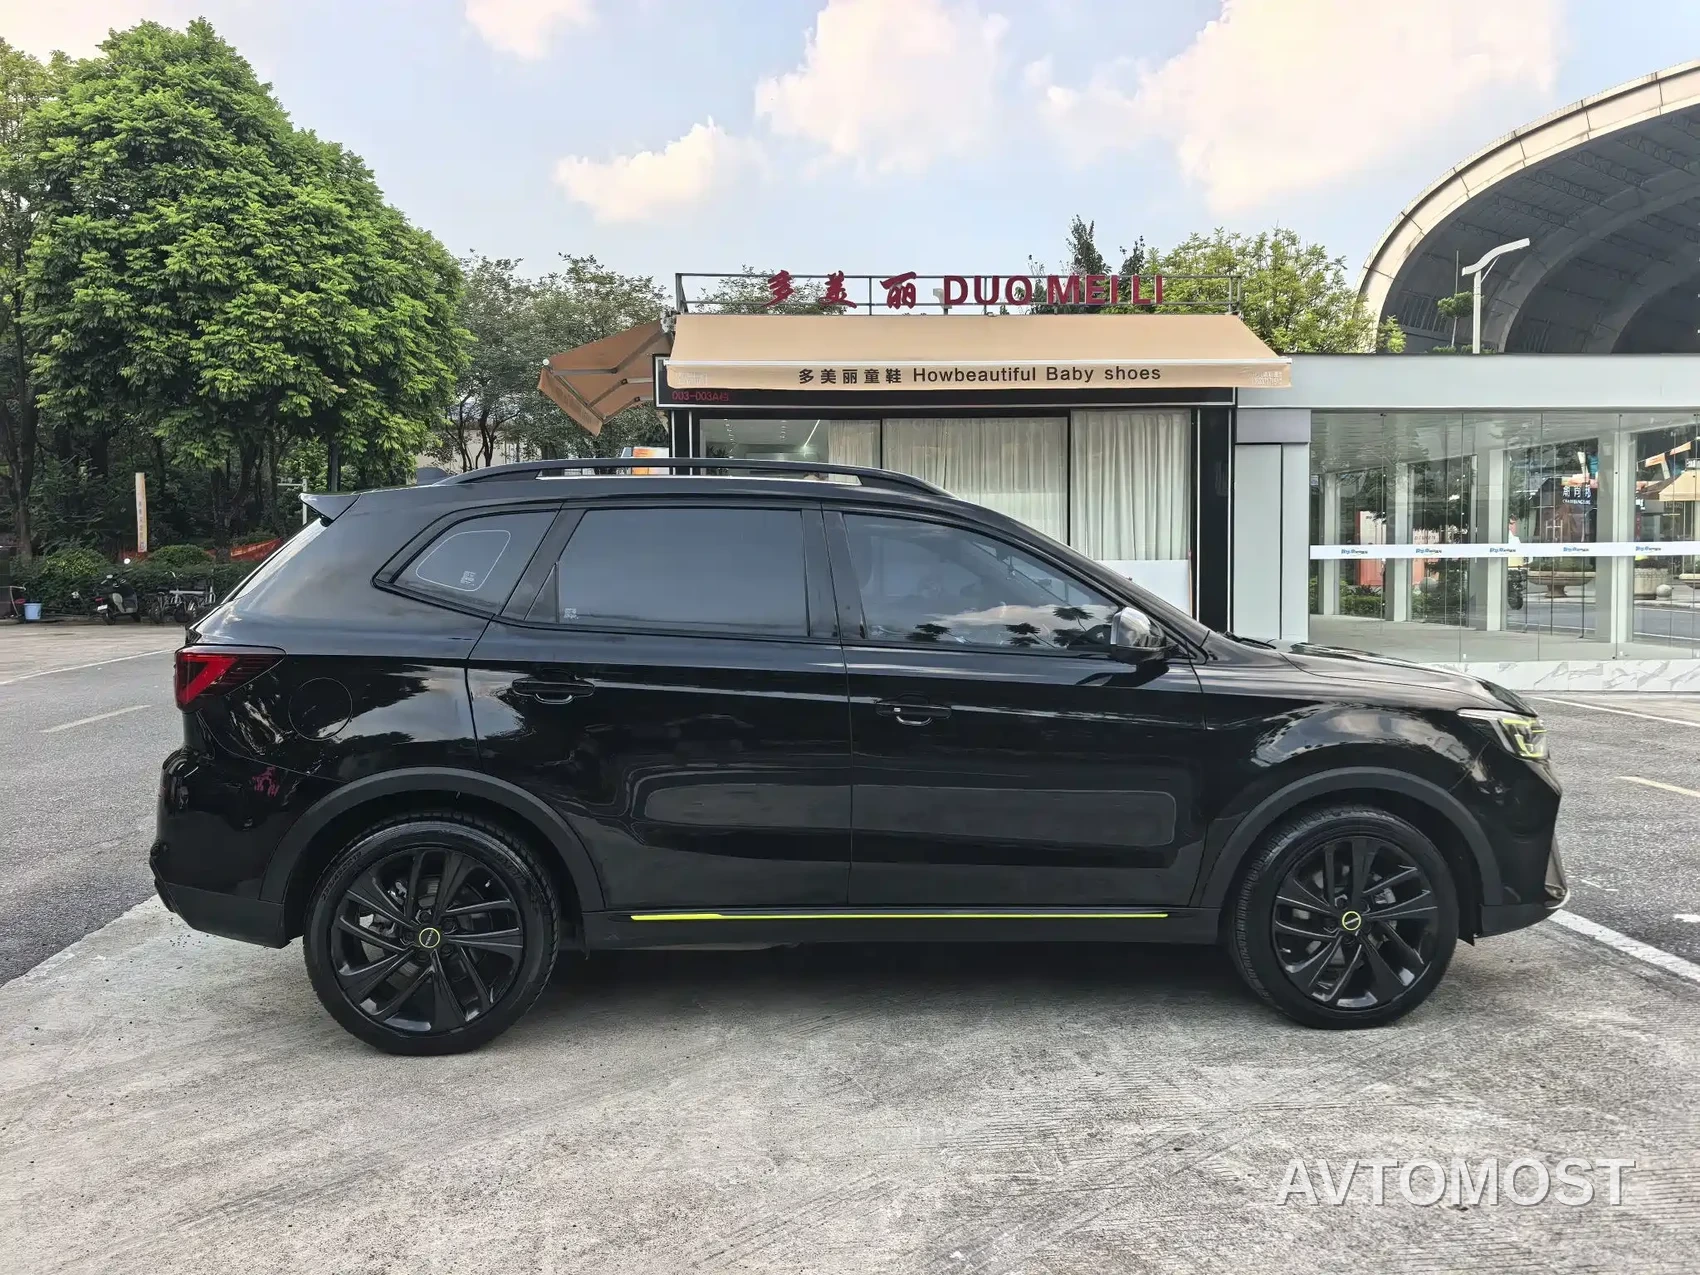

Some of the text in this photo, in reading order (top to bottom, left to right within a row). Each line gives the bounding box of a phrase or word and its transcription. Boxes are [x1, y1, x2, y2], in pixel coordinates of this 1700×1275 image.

[760, 269, 917, 309] 多美丽
[943, 275, 1033, 306] DUO
[798, 368, 902, 384] 多美丽童鞋
[913, 366, 1161, 383] Howbeautiful Baby shoes
